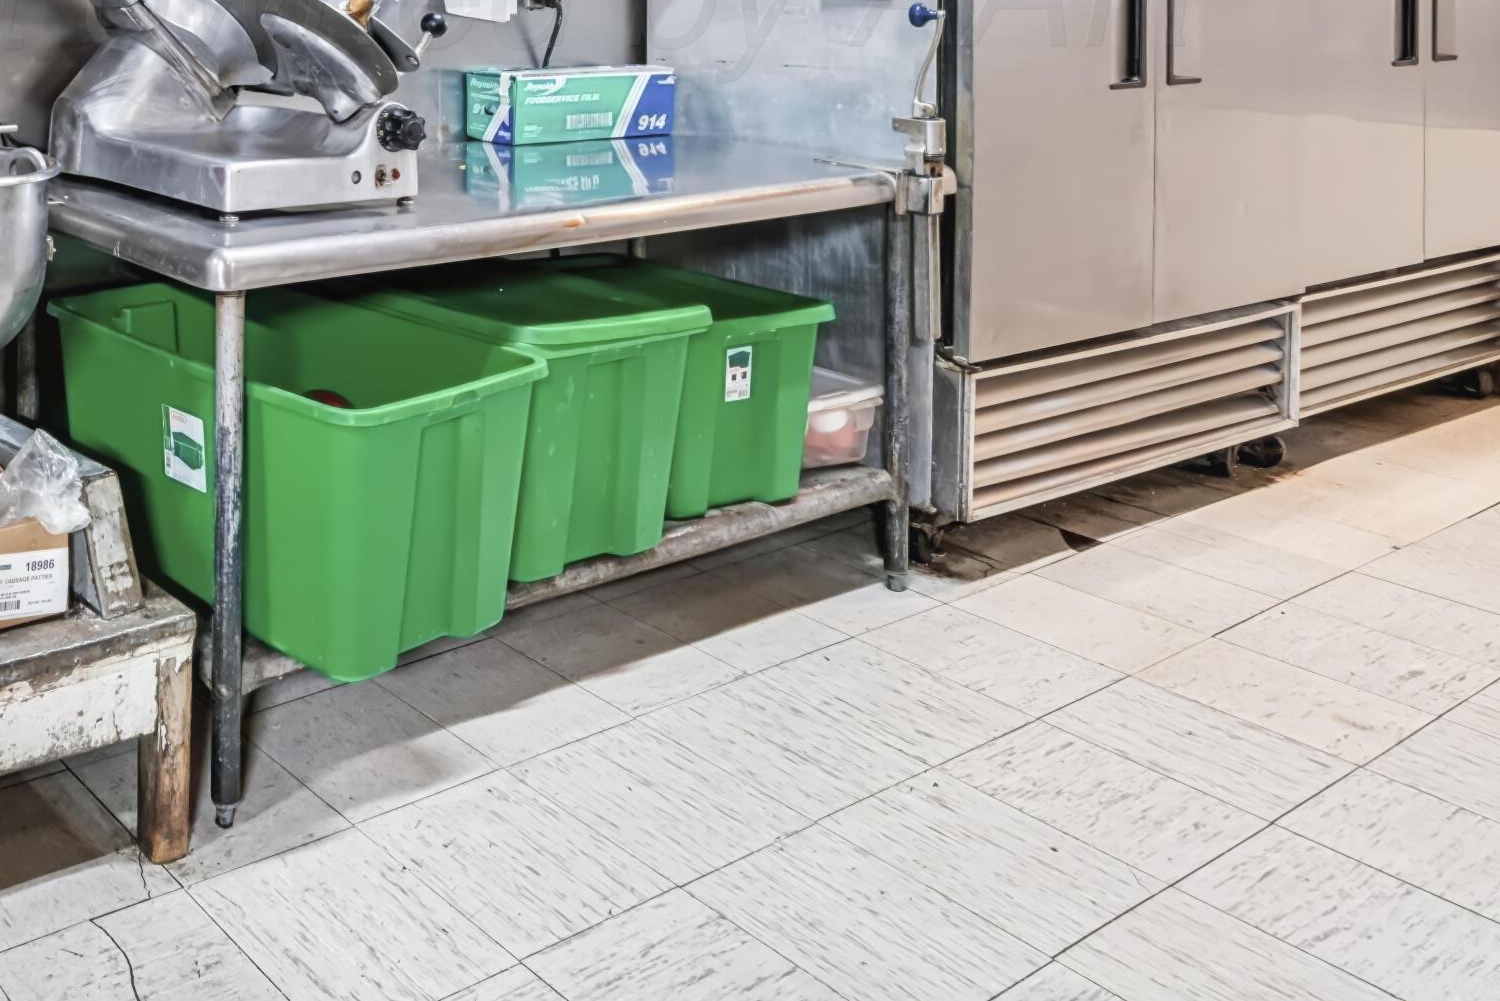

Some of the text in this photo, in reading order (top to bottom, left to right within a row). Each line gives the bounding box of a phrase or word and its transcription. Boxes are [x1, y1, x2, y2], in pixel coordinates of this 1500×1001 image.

[525, 92, 600, 105] FOODSERVICE FILM
[637, 113, 668, 131] 914
[25, 559, 55, 572] 18986
[4, 576, 30, 585] SAUSAGE
[30, 573, 53, 583] PATTIES
